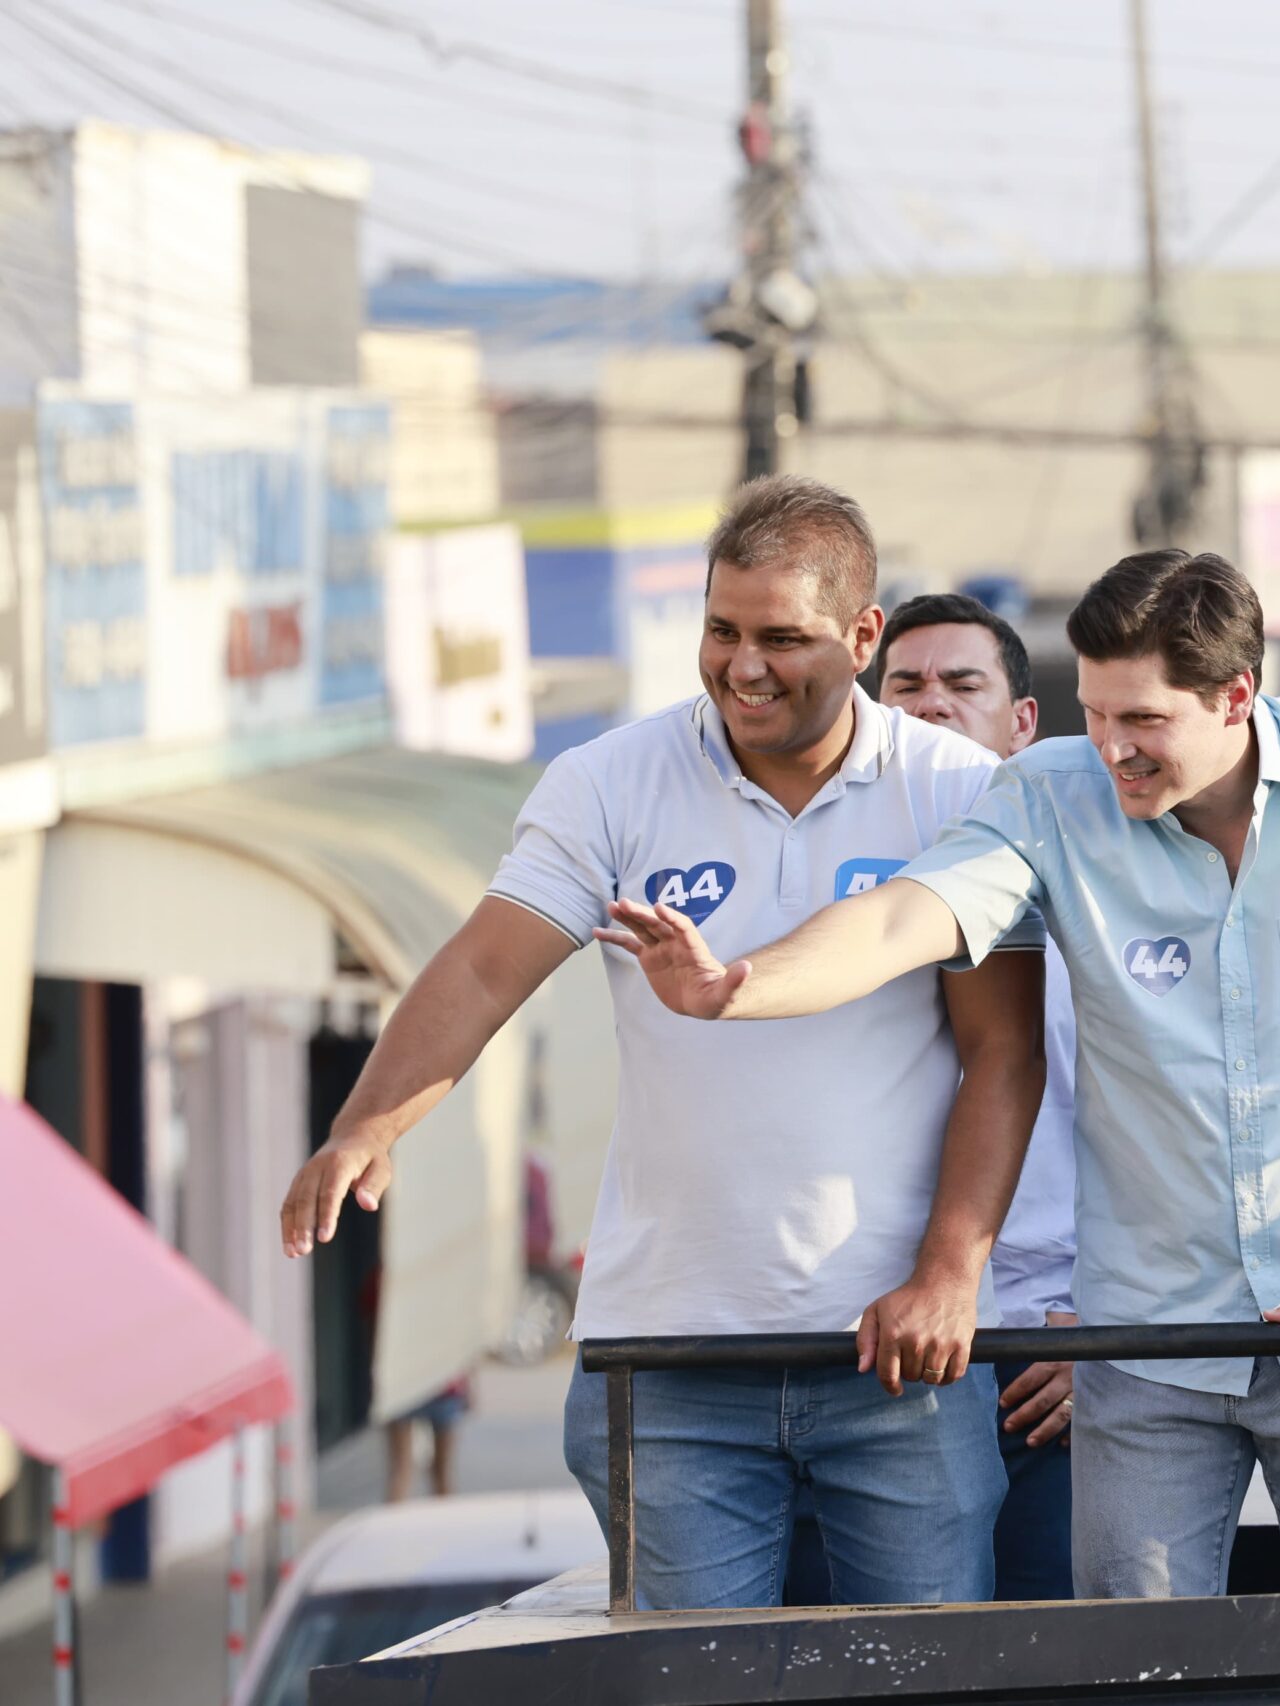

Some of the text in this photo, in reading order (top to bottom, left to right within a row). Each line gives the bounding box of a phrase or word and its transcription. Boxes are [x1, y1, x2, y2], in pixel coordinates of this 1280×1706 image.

[658, 868, 724, 907] 44
[845, 872, 893, 896] 4
[1130, 944, 1187, 979] 44
